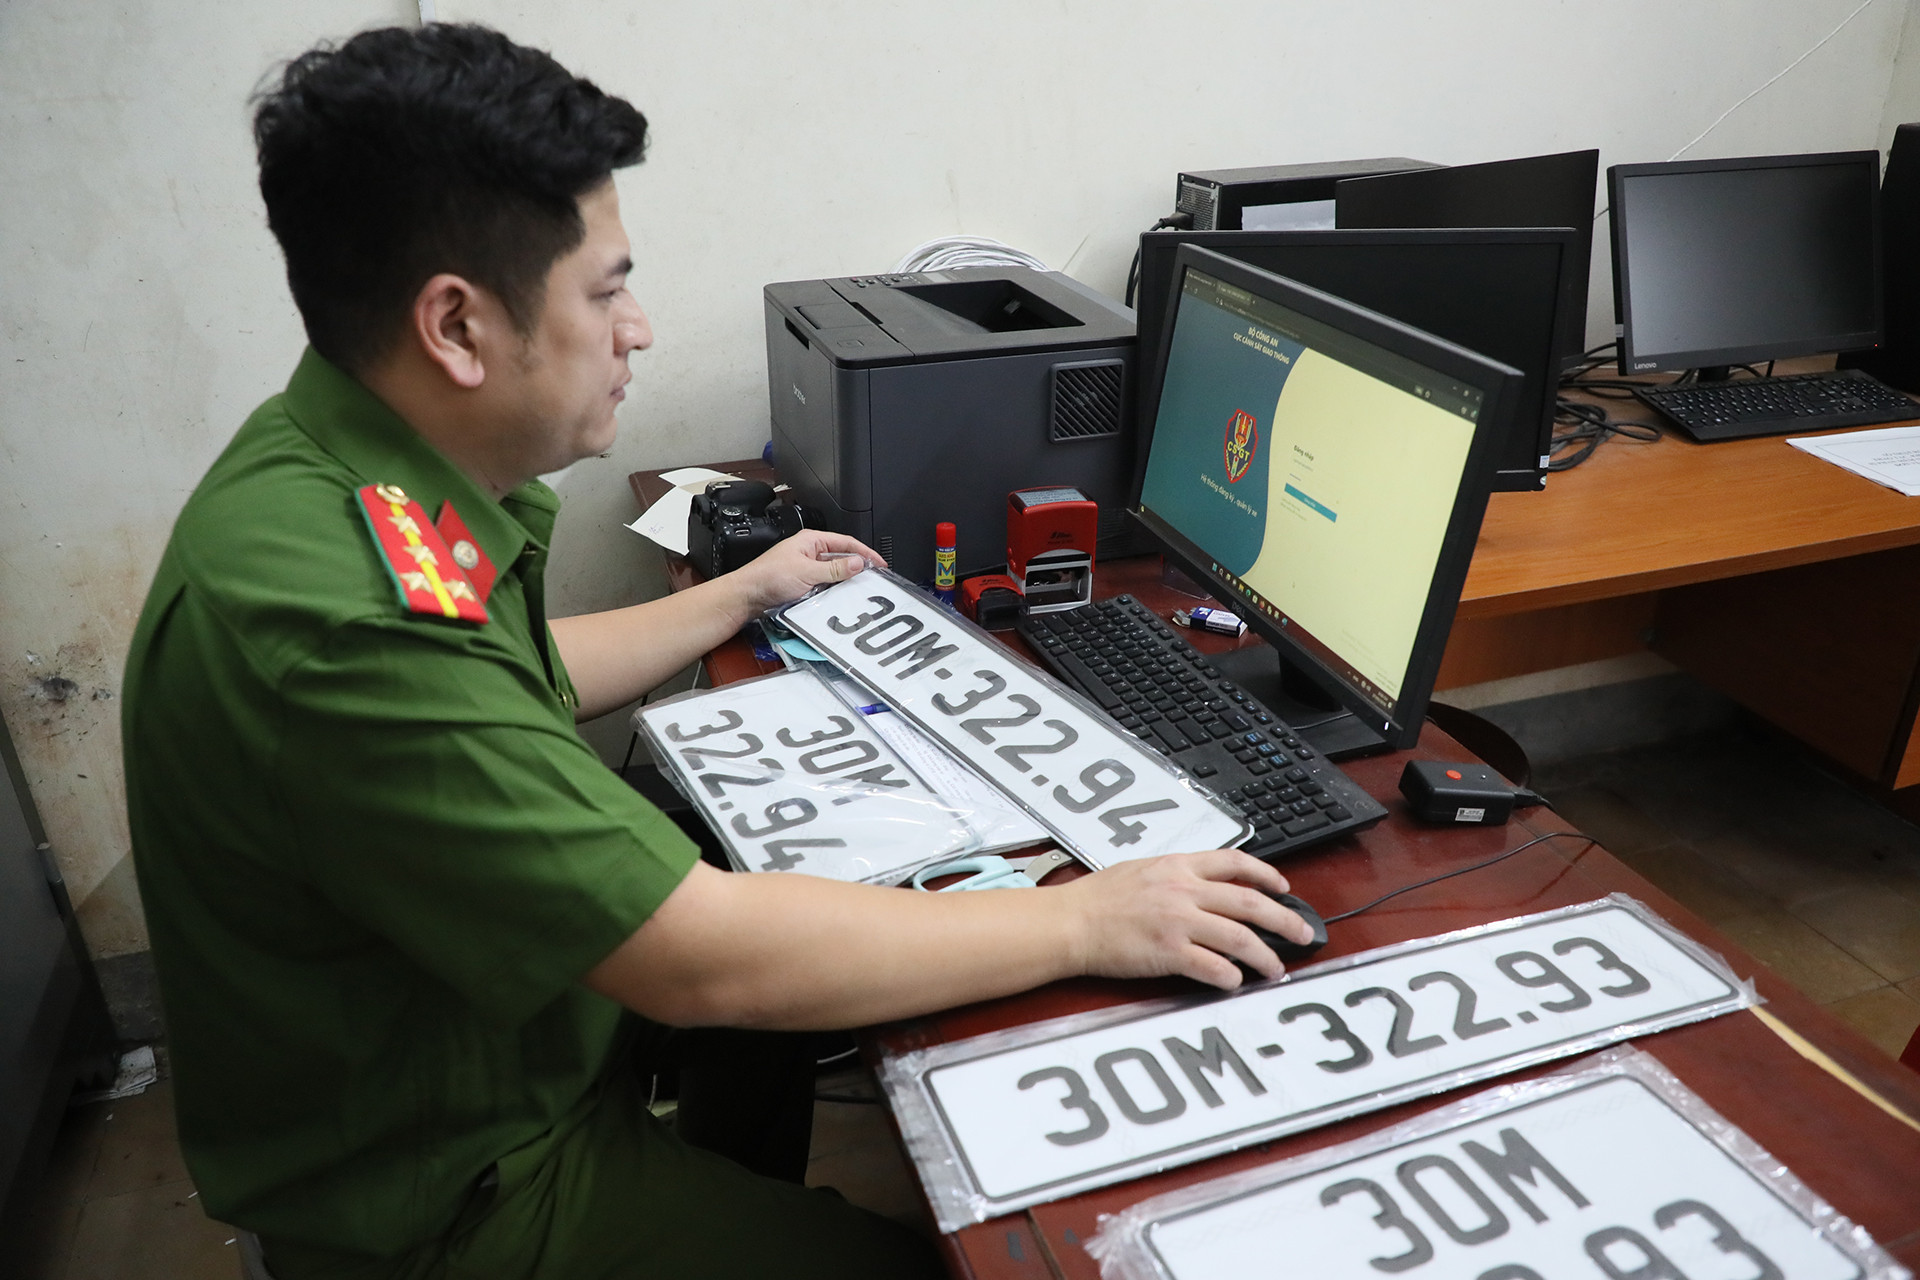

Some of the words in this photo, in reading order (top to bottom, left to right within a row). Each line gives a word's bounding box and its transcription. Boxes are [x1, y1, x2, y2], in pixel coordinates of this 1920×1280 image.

[1270, 337, 1279, 348] AN
[1634, 360, 1657, 370] Lenovo
[1227, 441, 1250, 461] CSGT
[776, 715, 911, 806] 30M
[826, 595, 1179, 848] 30M-322.94
[664, 709, 848, 872] 322.94
[1017, 936, 1651, 1147] 30M-322.93
[1320, 1127, 1592, 1273] 30M
